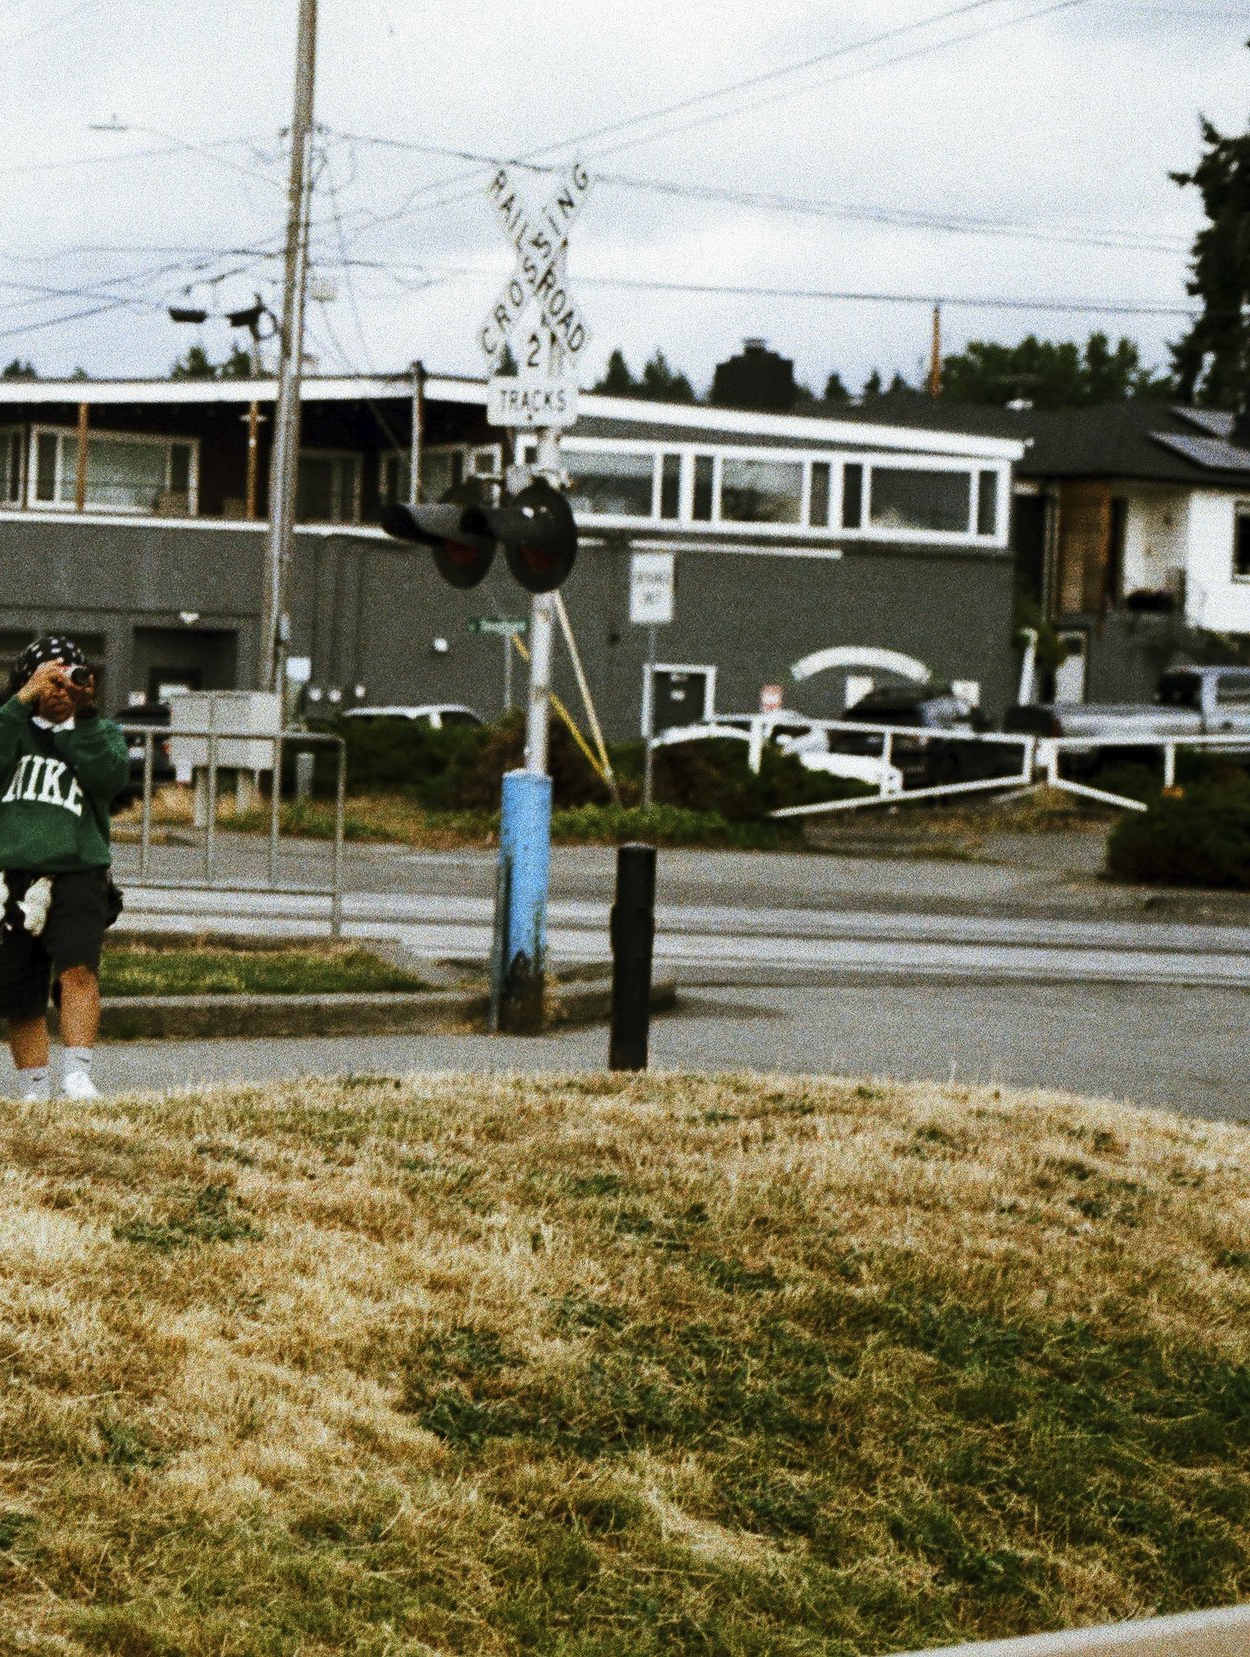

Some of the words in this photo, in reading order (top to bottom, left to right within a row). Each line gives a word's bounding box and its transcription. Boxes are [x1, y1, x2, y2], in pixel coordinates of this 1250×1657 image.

[480, 163, 588, 354] CROSSING
[489, 168, 586, 352] RAILROAD
[526, 332, 540, 367] 2
[500, 389, 567, 412] TRACKS
[1, 754, 84, 817] NIKE
